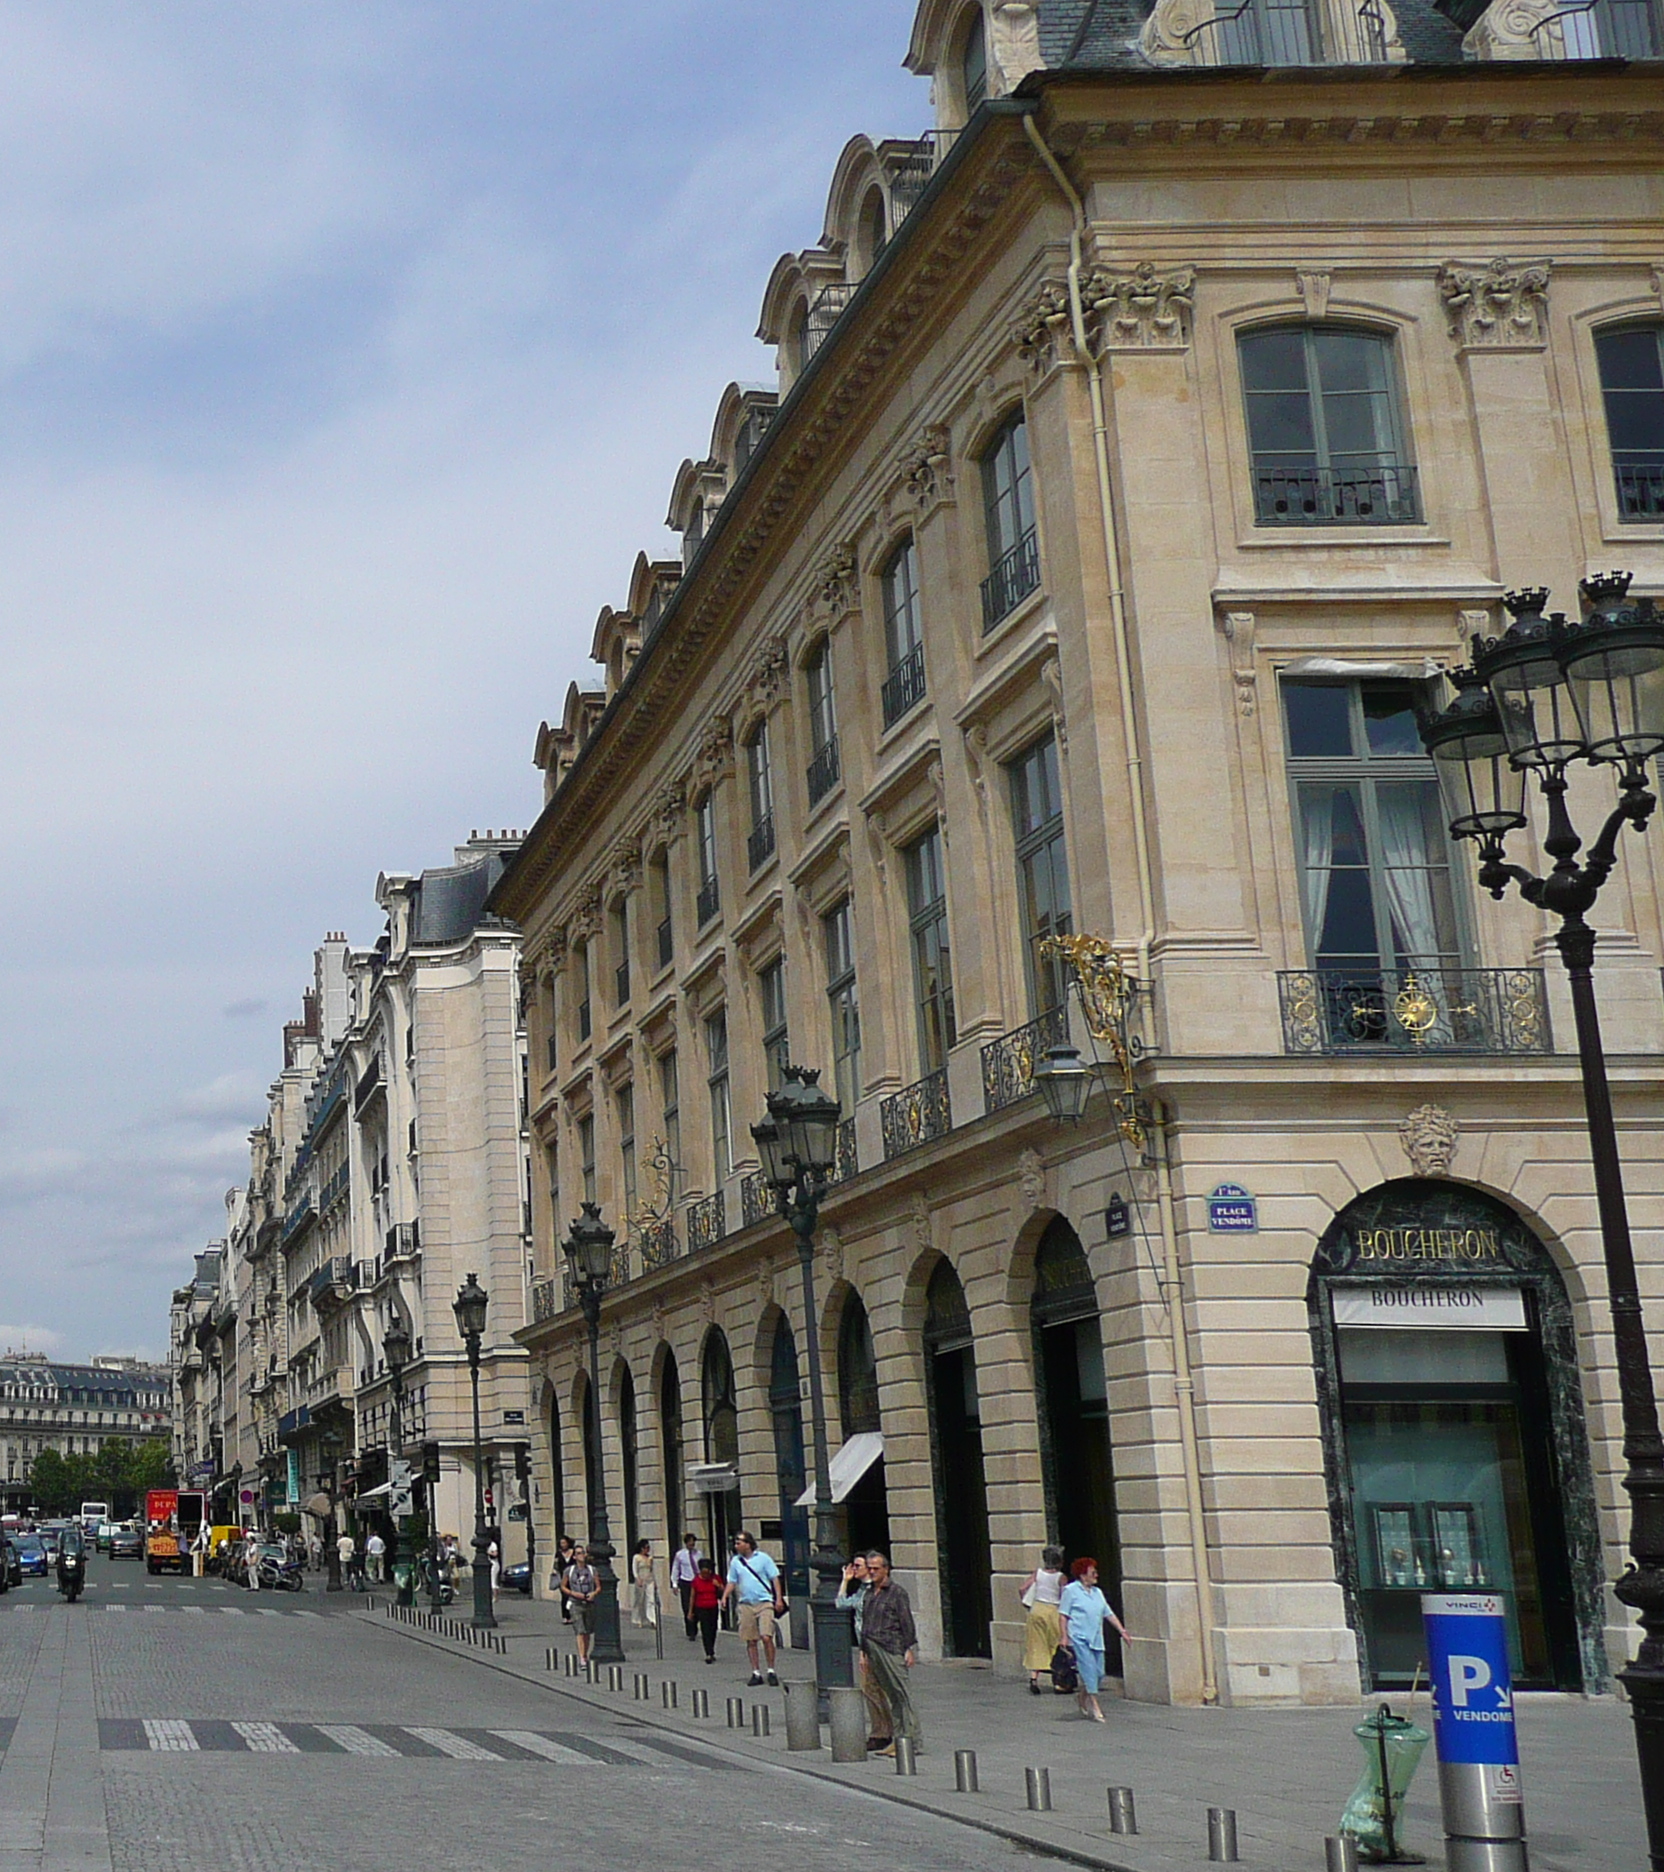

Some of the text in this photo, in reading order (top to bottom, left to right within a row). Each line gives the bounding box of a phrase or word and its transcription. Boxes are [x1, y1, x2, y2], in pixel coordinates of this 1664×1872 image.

[1216, 1206, 1248, 1216] PLACE
[1211, 1215, 1254, 1226] VENDÔME
[1358, 1229, 1498, 1260] BOUCHERON
[1371, 1289, 1484, 1308] BOUCHERON
[1448, 1654, 1491, 1706] P
[1453, 1709, 1513, 1722] VENDOME
